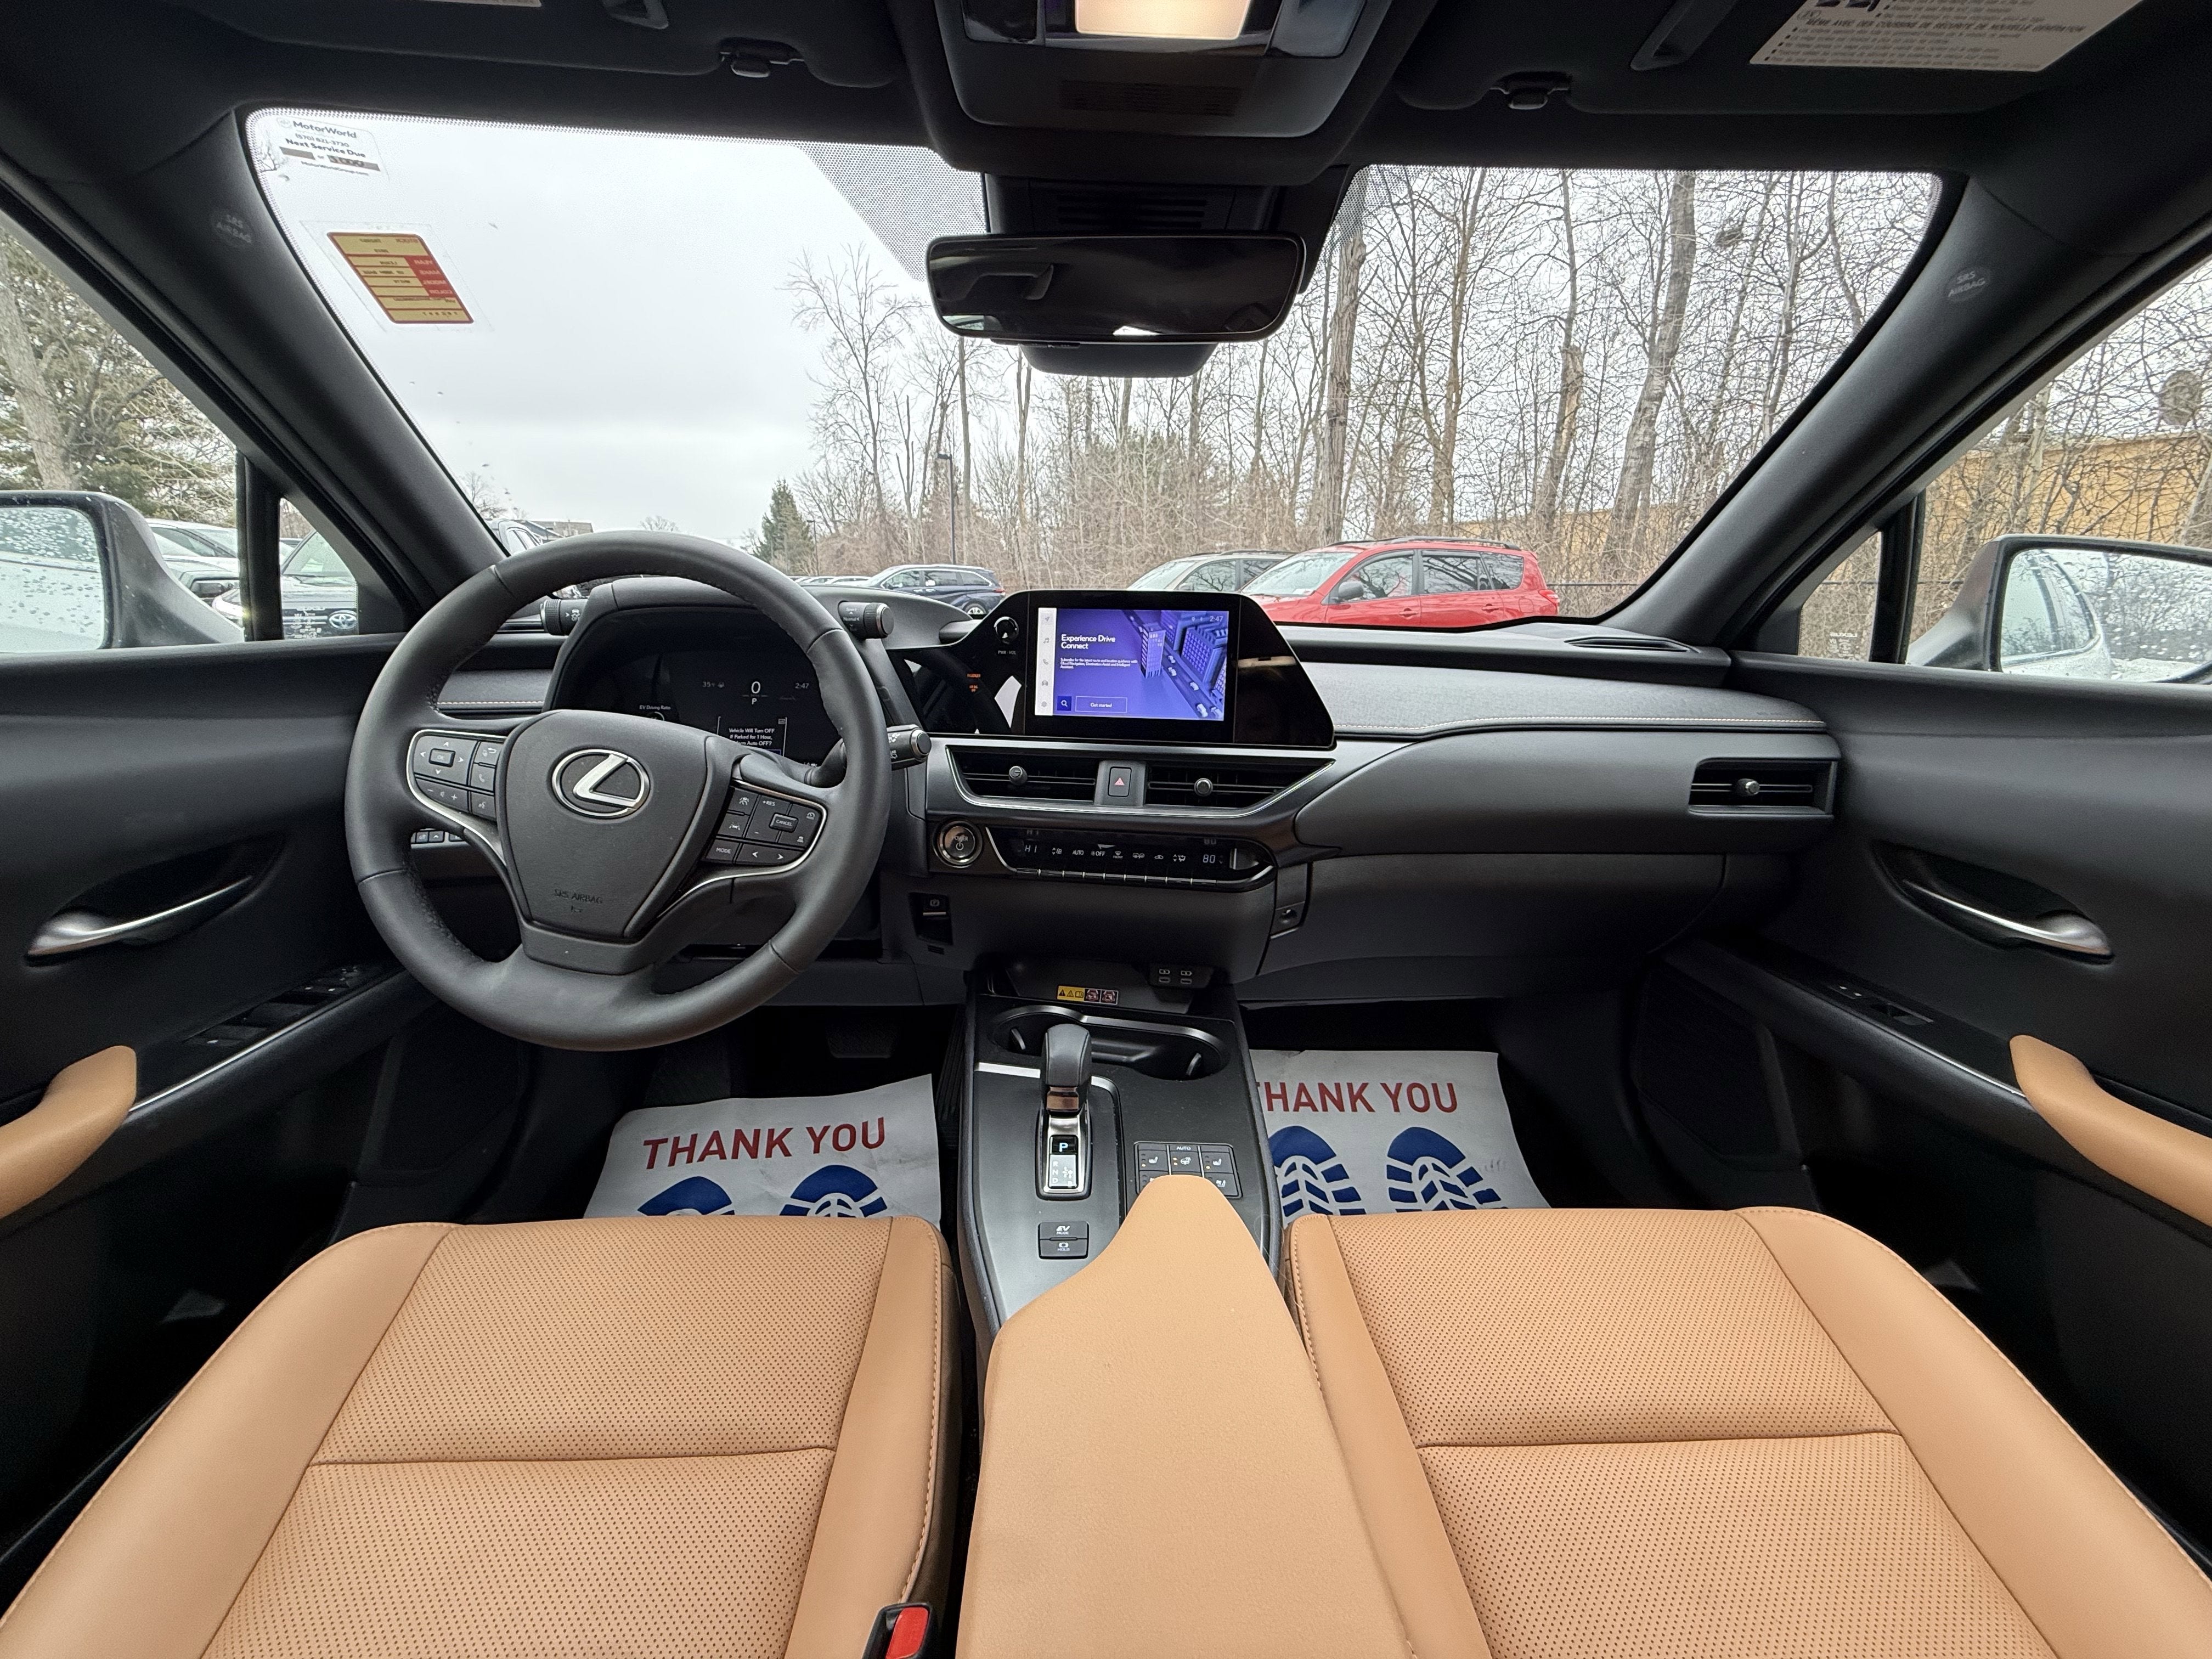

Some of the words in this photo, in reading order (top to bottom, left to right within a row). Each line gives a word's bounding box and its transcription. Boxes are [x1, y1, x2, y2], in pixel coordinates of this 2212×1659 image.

[292, 121, 357, 138] MotorWorld
[285, 138, 309, 148] Next
[311, 143, 346, 154] Service
[347, 149, 366, 158] Due
[1957, 271, 1976, 284] SRS
[1948, 278, 1985, 297] AIRBAG
[1061, 634, 1097, 643] Experience
[1098, 635, 1116, 643] Drive
[751, 681, 761, 694] 0
[1203, 854, 1216, 864] 80
[554, 889, 569, 899] SRS
[571, 893, 602, 904] AIRBAG
[1255, 1081, 1376, 1113] HANK
[1379, 1082, 1458, 1113] YOU
[642, 1127, 794, 1170] THANK
[805, 1116, 885, 1154] YOU
[1059, 1142, 1069, 1152] P
